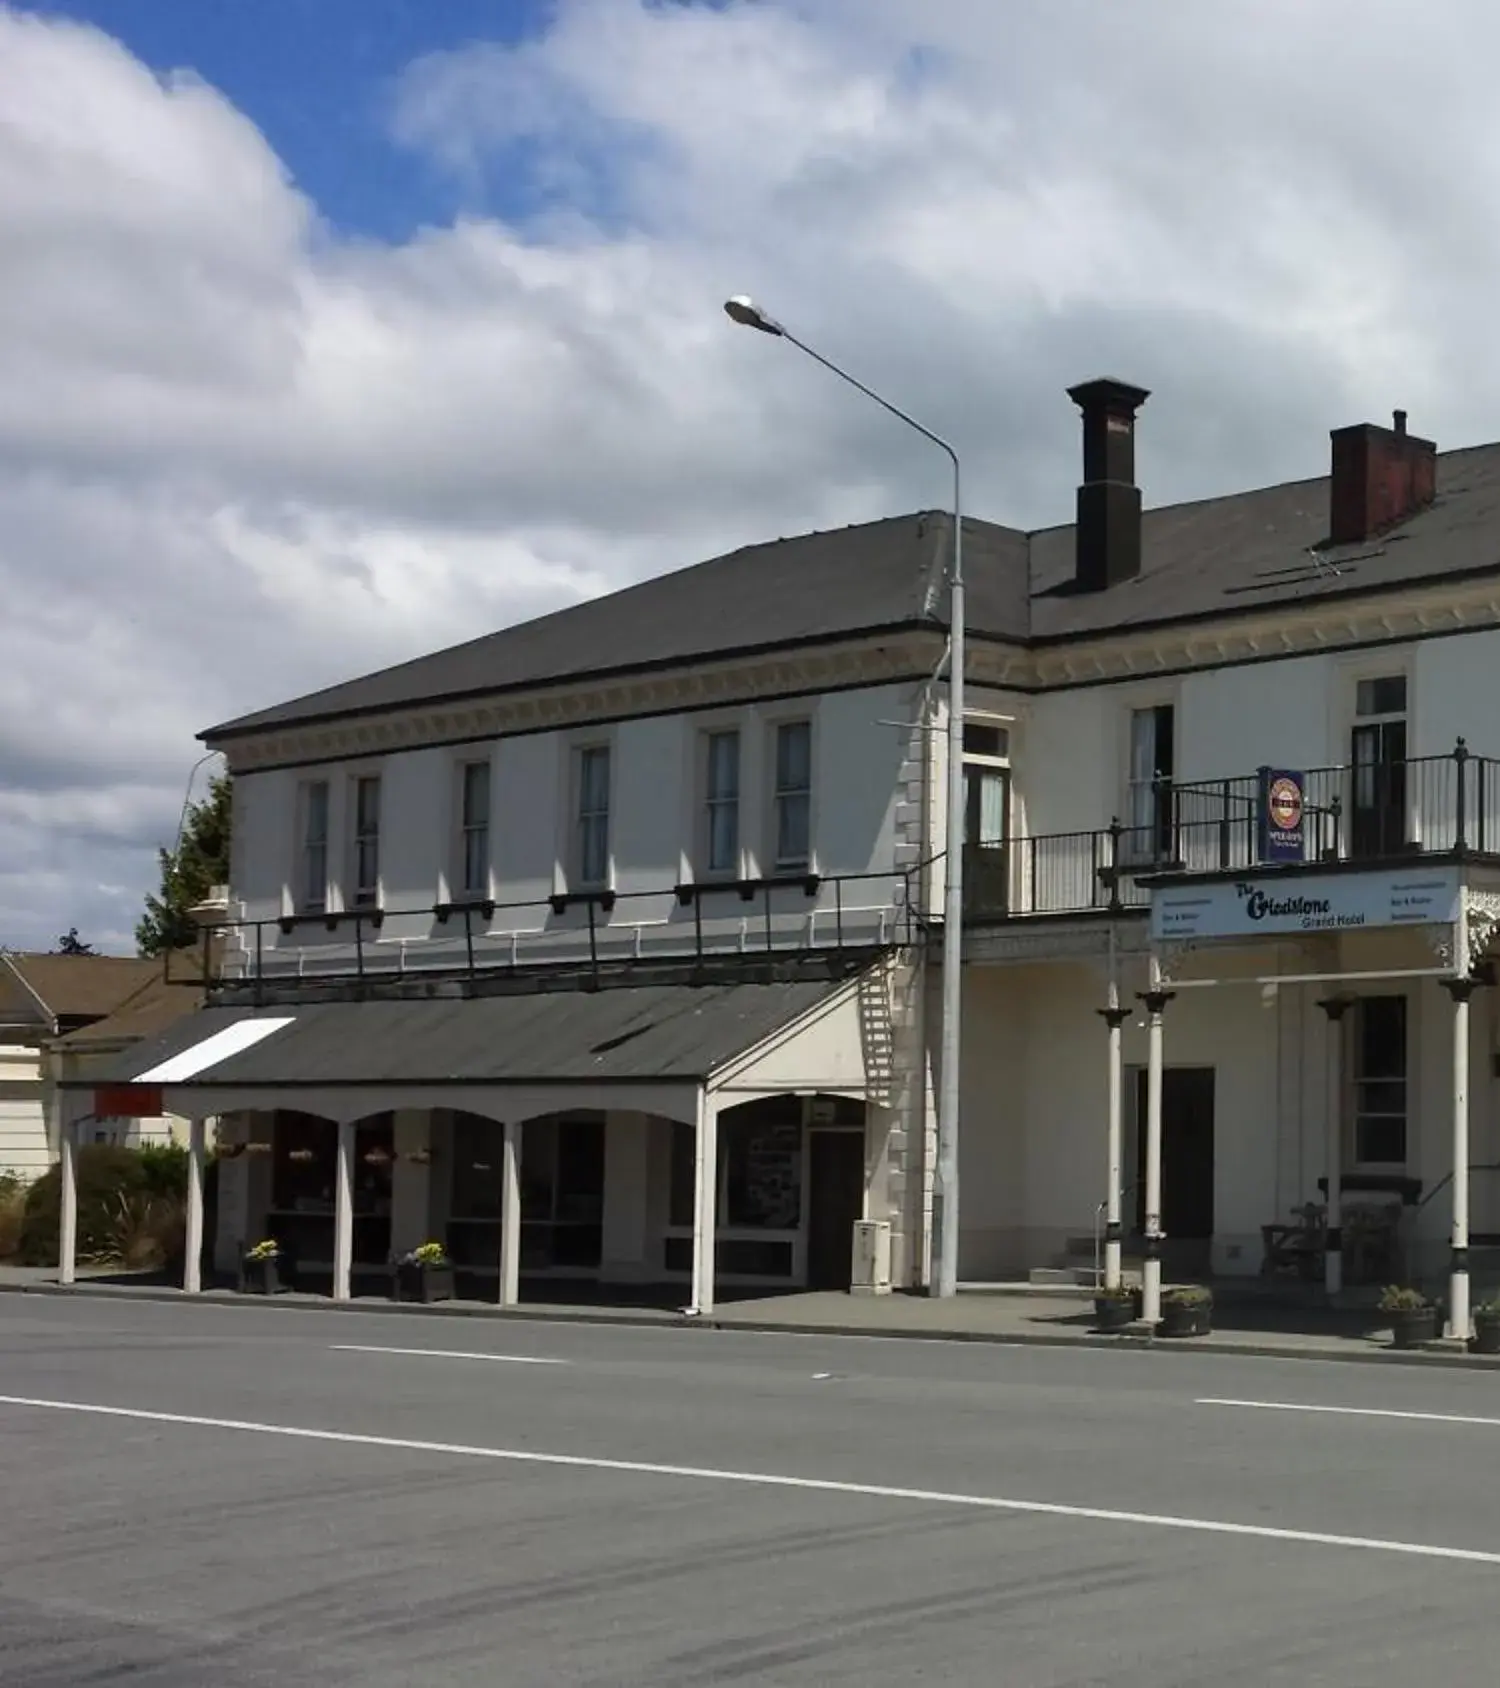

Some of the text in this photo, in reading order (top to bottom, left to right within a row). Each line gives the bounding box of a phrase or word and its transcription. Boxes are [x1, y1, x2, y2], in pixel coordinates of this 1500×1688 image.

[1247, 890, 1331, 920] Gladstone
[1302, 912, 1365, 928] Grand Hotel
